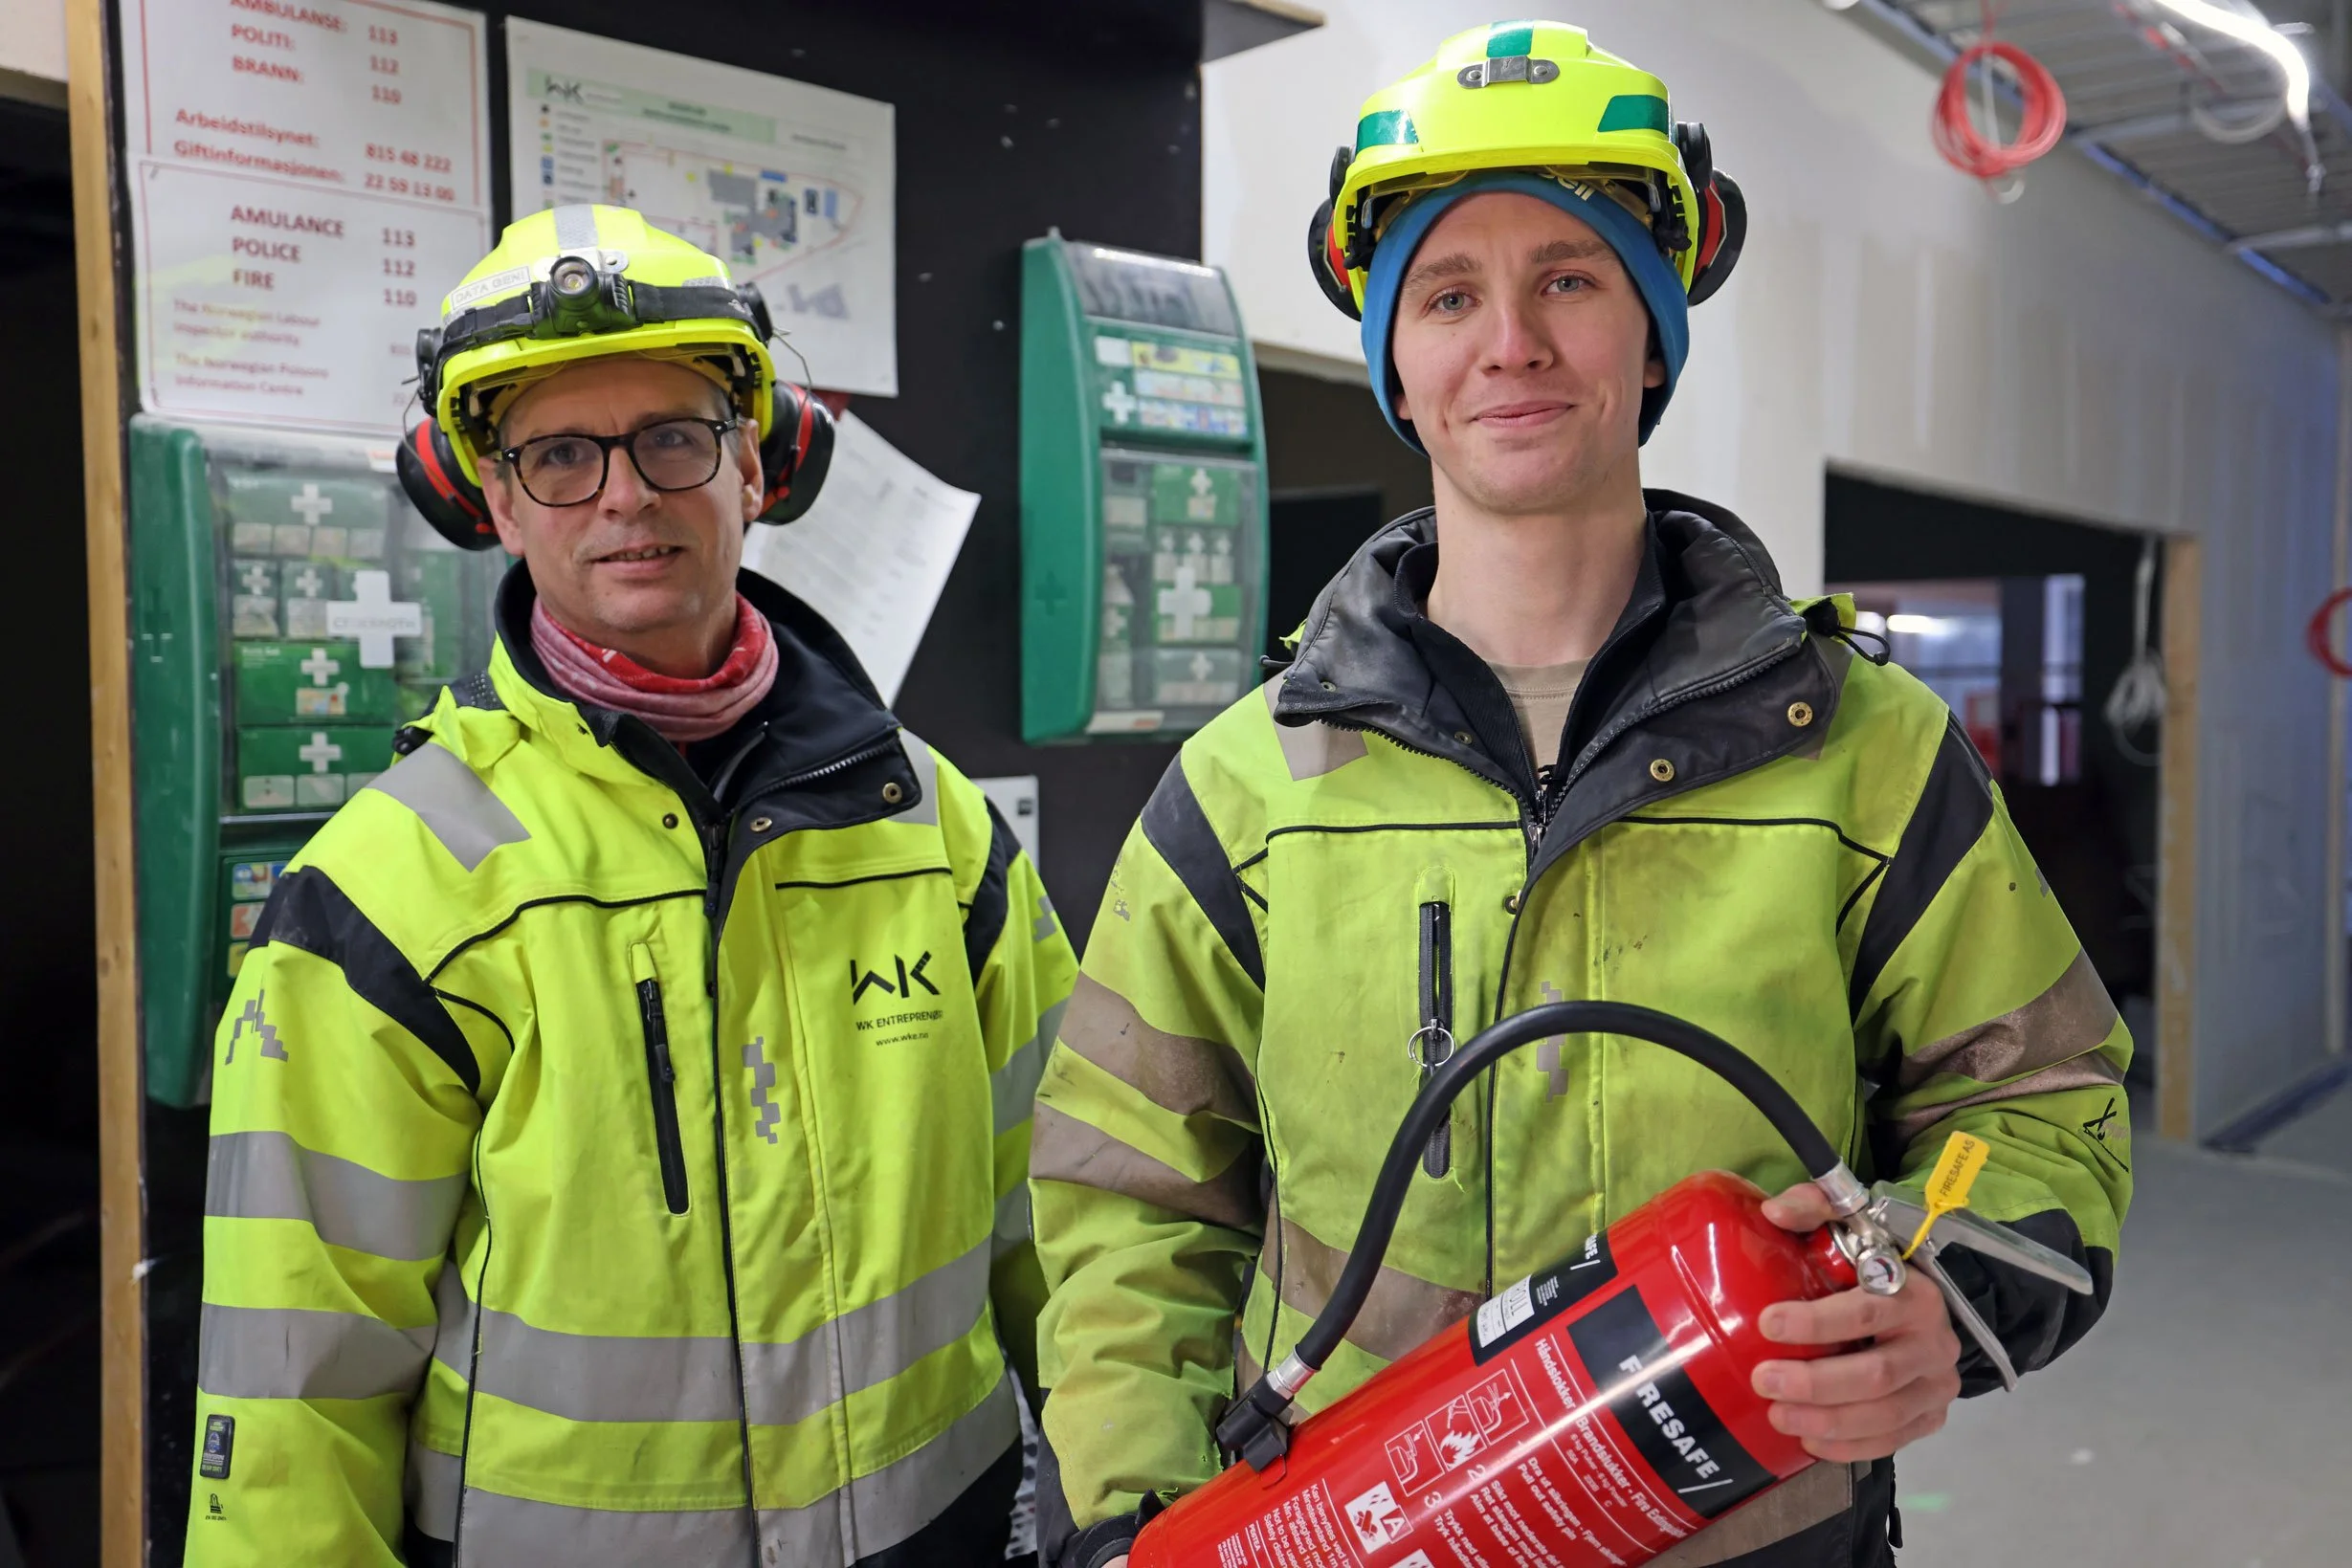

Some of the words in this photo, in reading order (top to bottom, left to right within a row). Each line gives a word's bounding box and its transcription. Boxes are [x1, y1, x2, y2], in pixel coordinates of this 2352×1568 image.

[231, 24, 295, 51] POLITI:
[370, 55, 399, 74] 112
[368, 25, 398, 45] 113
[233, 55, 303, 83] BRANN:
[371, 86, 401, 104] 110
[366, 143, 395, 162] 815
[424, 154, 452, 172] 222
[365, 173, 384, 189] 22
[231, 205, 344, 238] AMULANCE
[383, 228, 415, 248] 113
[233, 236, 300, 263] POLICE
[383, 257, 415, 277] 112
[233, 269, 274, 290] FIRE
[384, 288, 417, 307] 110
[856, 1019, 875, 1031] WK
[1939, 1152, 1969, 1197] FIRESAFE
[1962, 1138, 1976, 1154] AS
[1535, 1337, 1577, 1411] Håndslokker
[1575, 1416, 1631, 1490] Brandslukker
[1631, 1491, 1652, 1512] Fire
[1618, 1354, 1720, 1480] FRESAFE
[1467, 1464, 1485, 1483] 2
[1526, 1456, 1543, 1476] Dra
[1539, 1474, 1552, 1489] ut
[1547, 1487, 1581, 1528] sikringen
[1271, 1507, 1281, 1525] Not
[1301, 1489, 1331, 1552] Minsteavstand
[1424, 1491, 1442, 1508] 3
[1479, 1486, 1497, 1505] Ret
[1491, 1504, 1521, 1541] slangen
[1490, 1479, 1508, 1501] Sikt
[1502, 1499, 1520, 1520] mot
[1516, 1463, 1535, 1484] Pull
[1529, 1483, 1546, 1501] out
[1542, 1499, 1566, 1528] safety
[1561, 1525, 1578, 1540] pin
[1263, 1513, 1276, 1540] Safety
[1276, 1525, 1284, 1535] to
[1279, 1535, 1289, 1548] be
[1281, 1501, 1292, 1521] Min.
[1288, 1520, 1308, 1555] afstand
[1290, 1495, 1316, 1550] Forsigtighed
[1310, 1483, 1320, 1502] Kan
[1316, 1501, 1337, 1540] benyttes
[1332, 1540, 1346, 1559] ved
[1382, 1517, 1405, 1537] A
[1432, 1514, 1452, 1537] Tryk
[1442, 1509, 1465, 1536] Trykk
[1460, 1535, 1478, 1556] ned
[1469, 1492, 1487, 1513] Aim
[1481, 1512, 1494, 1525] at
[1489, 1522, 1511, 1547] base
[1506, 1545, 1520, 1557] of
